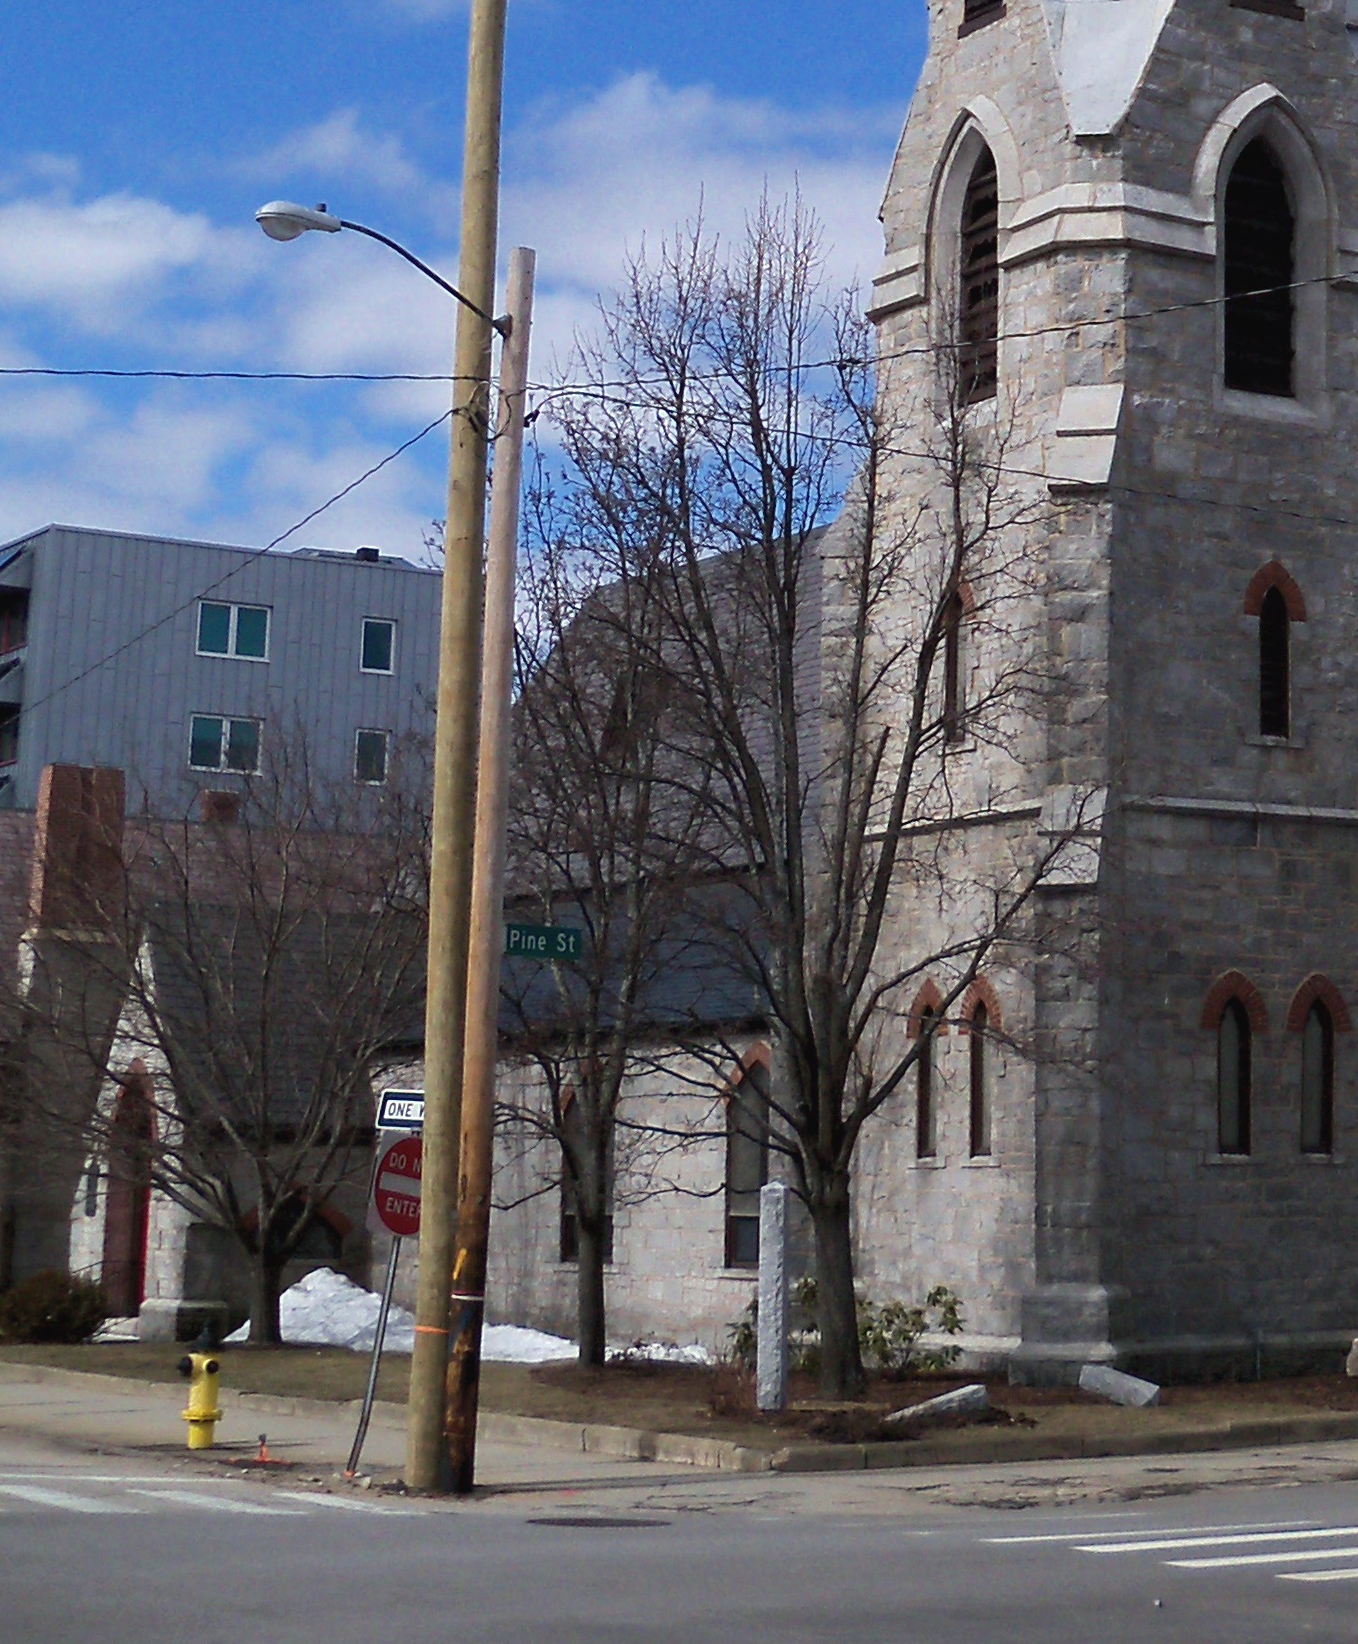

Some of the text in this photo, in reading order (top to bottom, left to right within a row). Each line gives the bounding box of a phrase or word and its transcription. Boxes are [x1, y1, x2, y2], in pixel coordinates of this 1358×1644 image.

[510, 930, 575, 952] Pine St
[388, 1102, 413, 1117] ONE
[389, 1153, 406, 1170] DO
